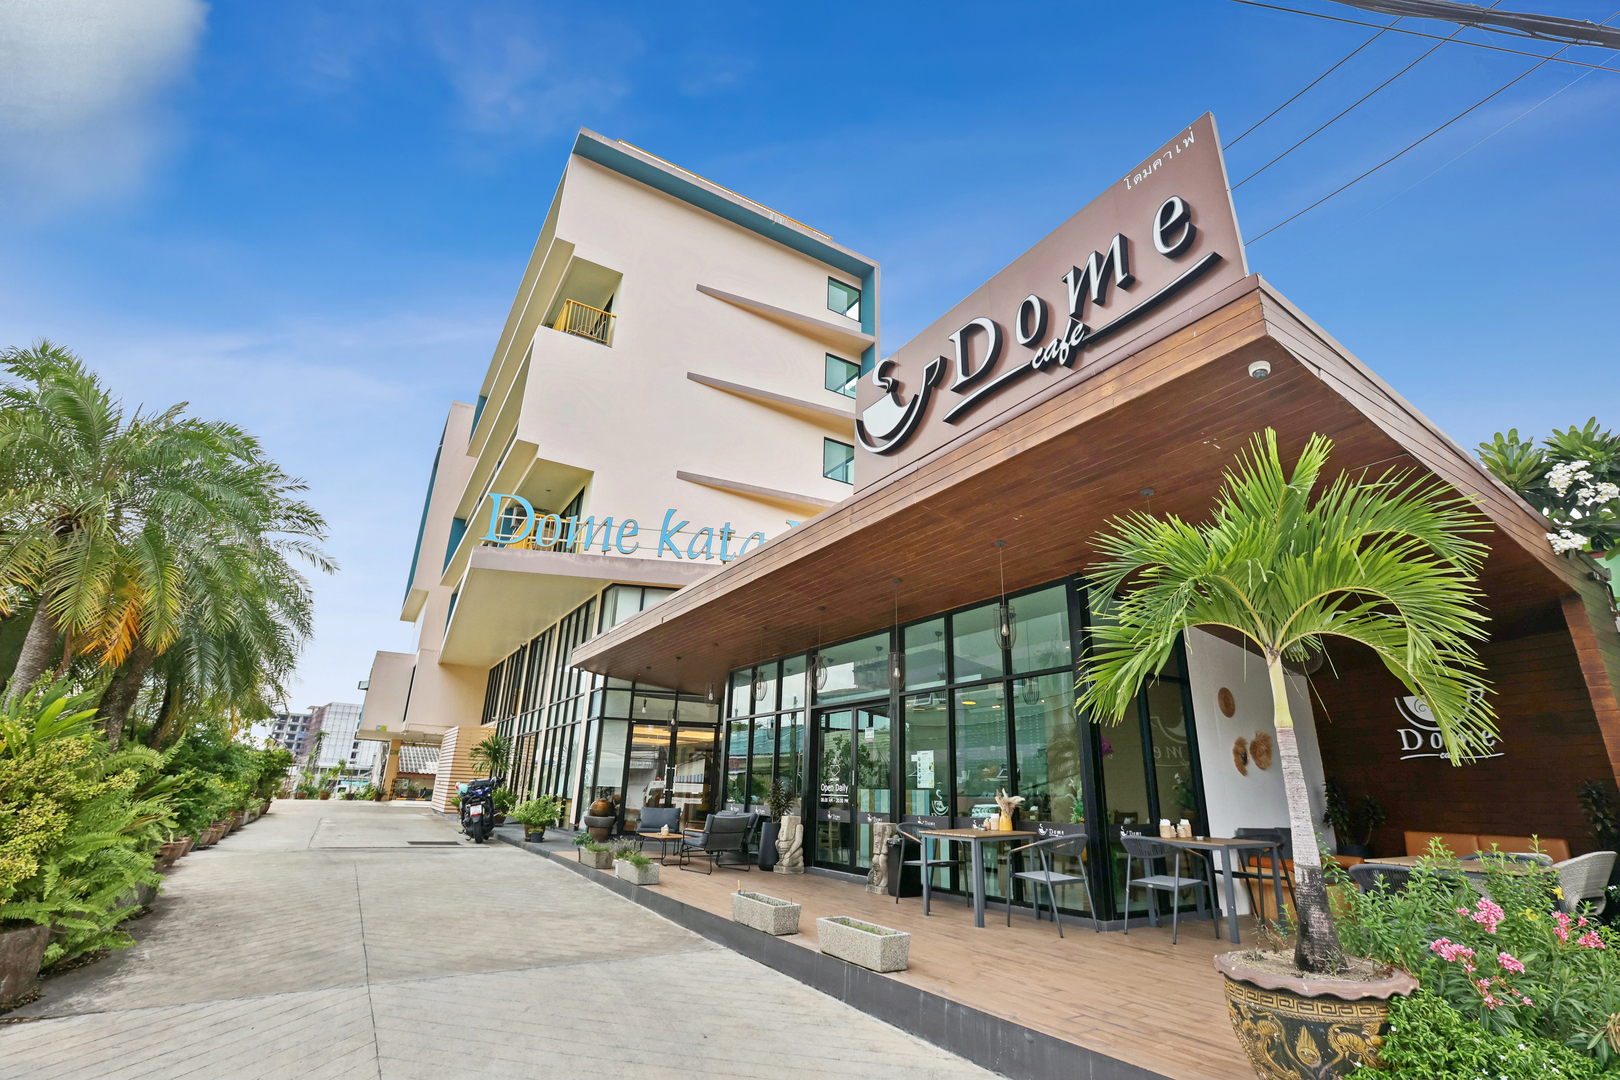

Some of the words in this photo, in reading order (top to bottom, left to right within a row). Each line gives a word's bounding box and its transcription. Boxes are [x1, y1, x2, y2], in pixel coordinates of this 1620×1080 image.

[1123, 125, 1195, 190] โดมคาเฟ่
[948, 194, 1198, 394] Dome
[1031, 317, 1090, 372] cafe
[479, 492, 640, 555] Dome
[821, 783, 834, 793] Open
[835, 783, 849, 794] Daily
